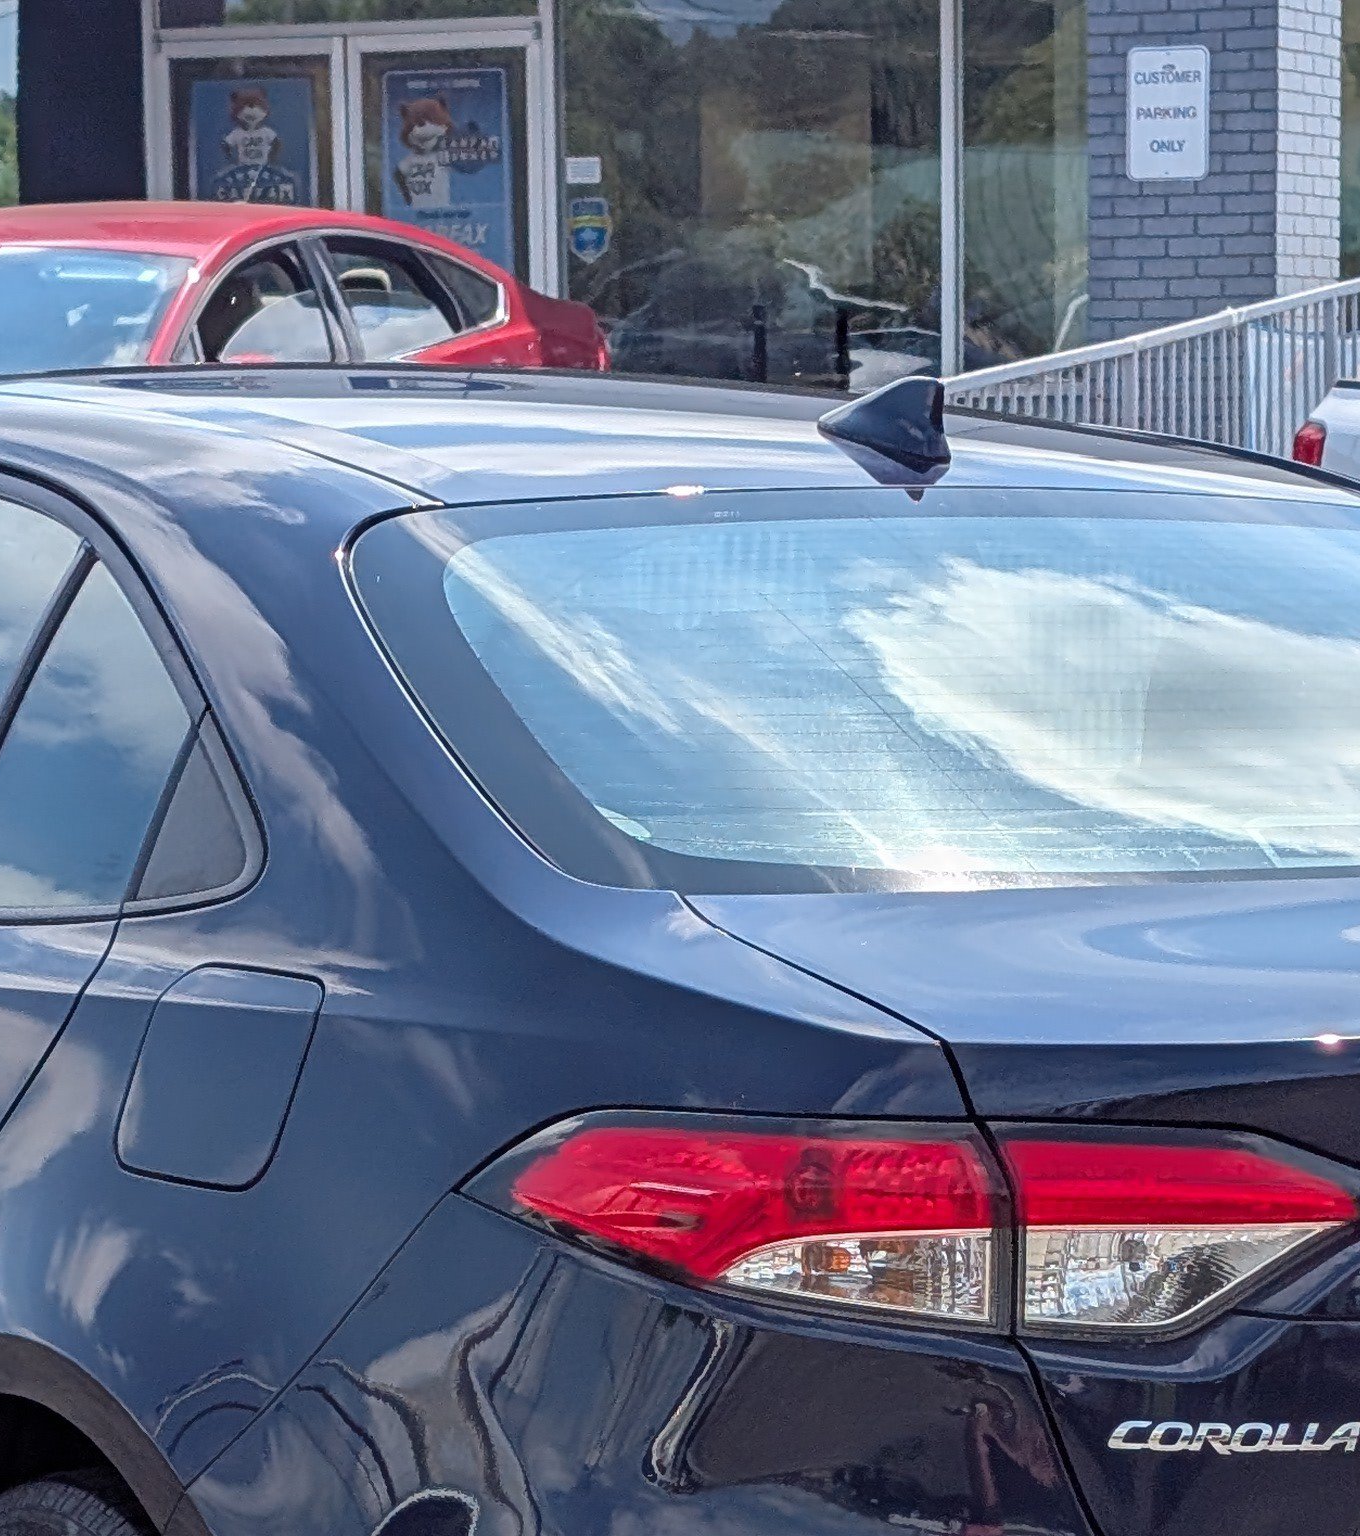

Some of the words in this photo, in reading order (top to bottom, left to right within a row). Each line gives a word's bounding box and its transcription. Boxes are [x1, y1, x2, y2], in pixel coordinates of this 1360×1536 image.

[1134, 70, 1202, 85] CUSTOMER
[1136, 106, 1197, 120] PARKING
[1149, 140, 1185, 153] ONLY
